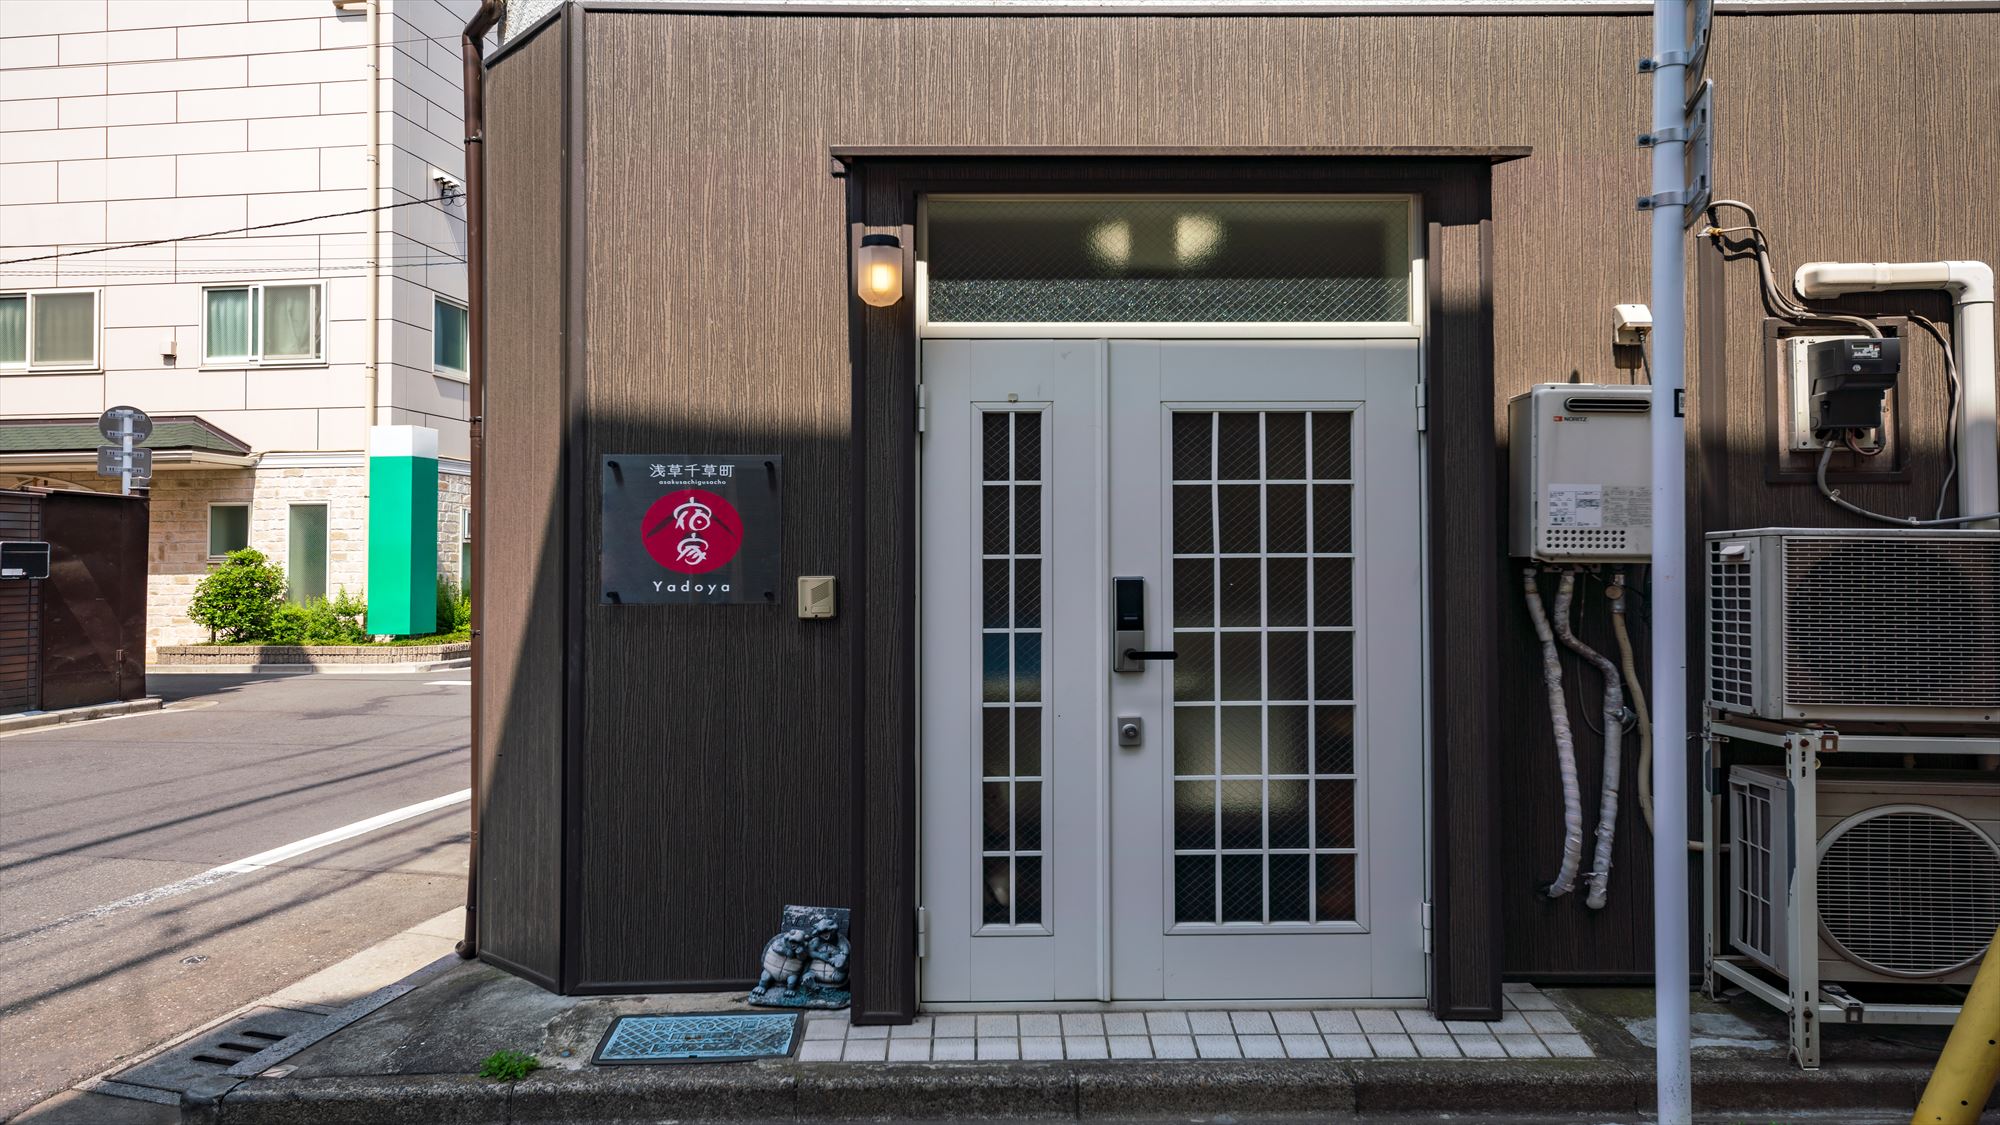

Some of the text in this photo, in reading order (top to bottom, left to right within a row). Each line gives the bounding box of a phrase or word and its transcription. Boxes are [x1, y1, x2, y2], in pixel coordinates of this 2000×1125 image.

[649, 463, 736, 478] 浅草千草町
[652, 580, 731, 596] Yadoya
